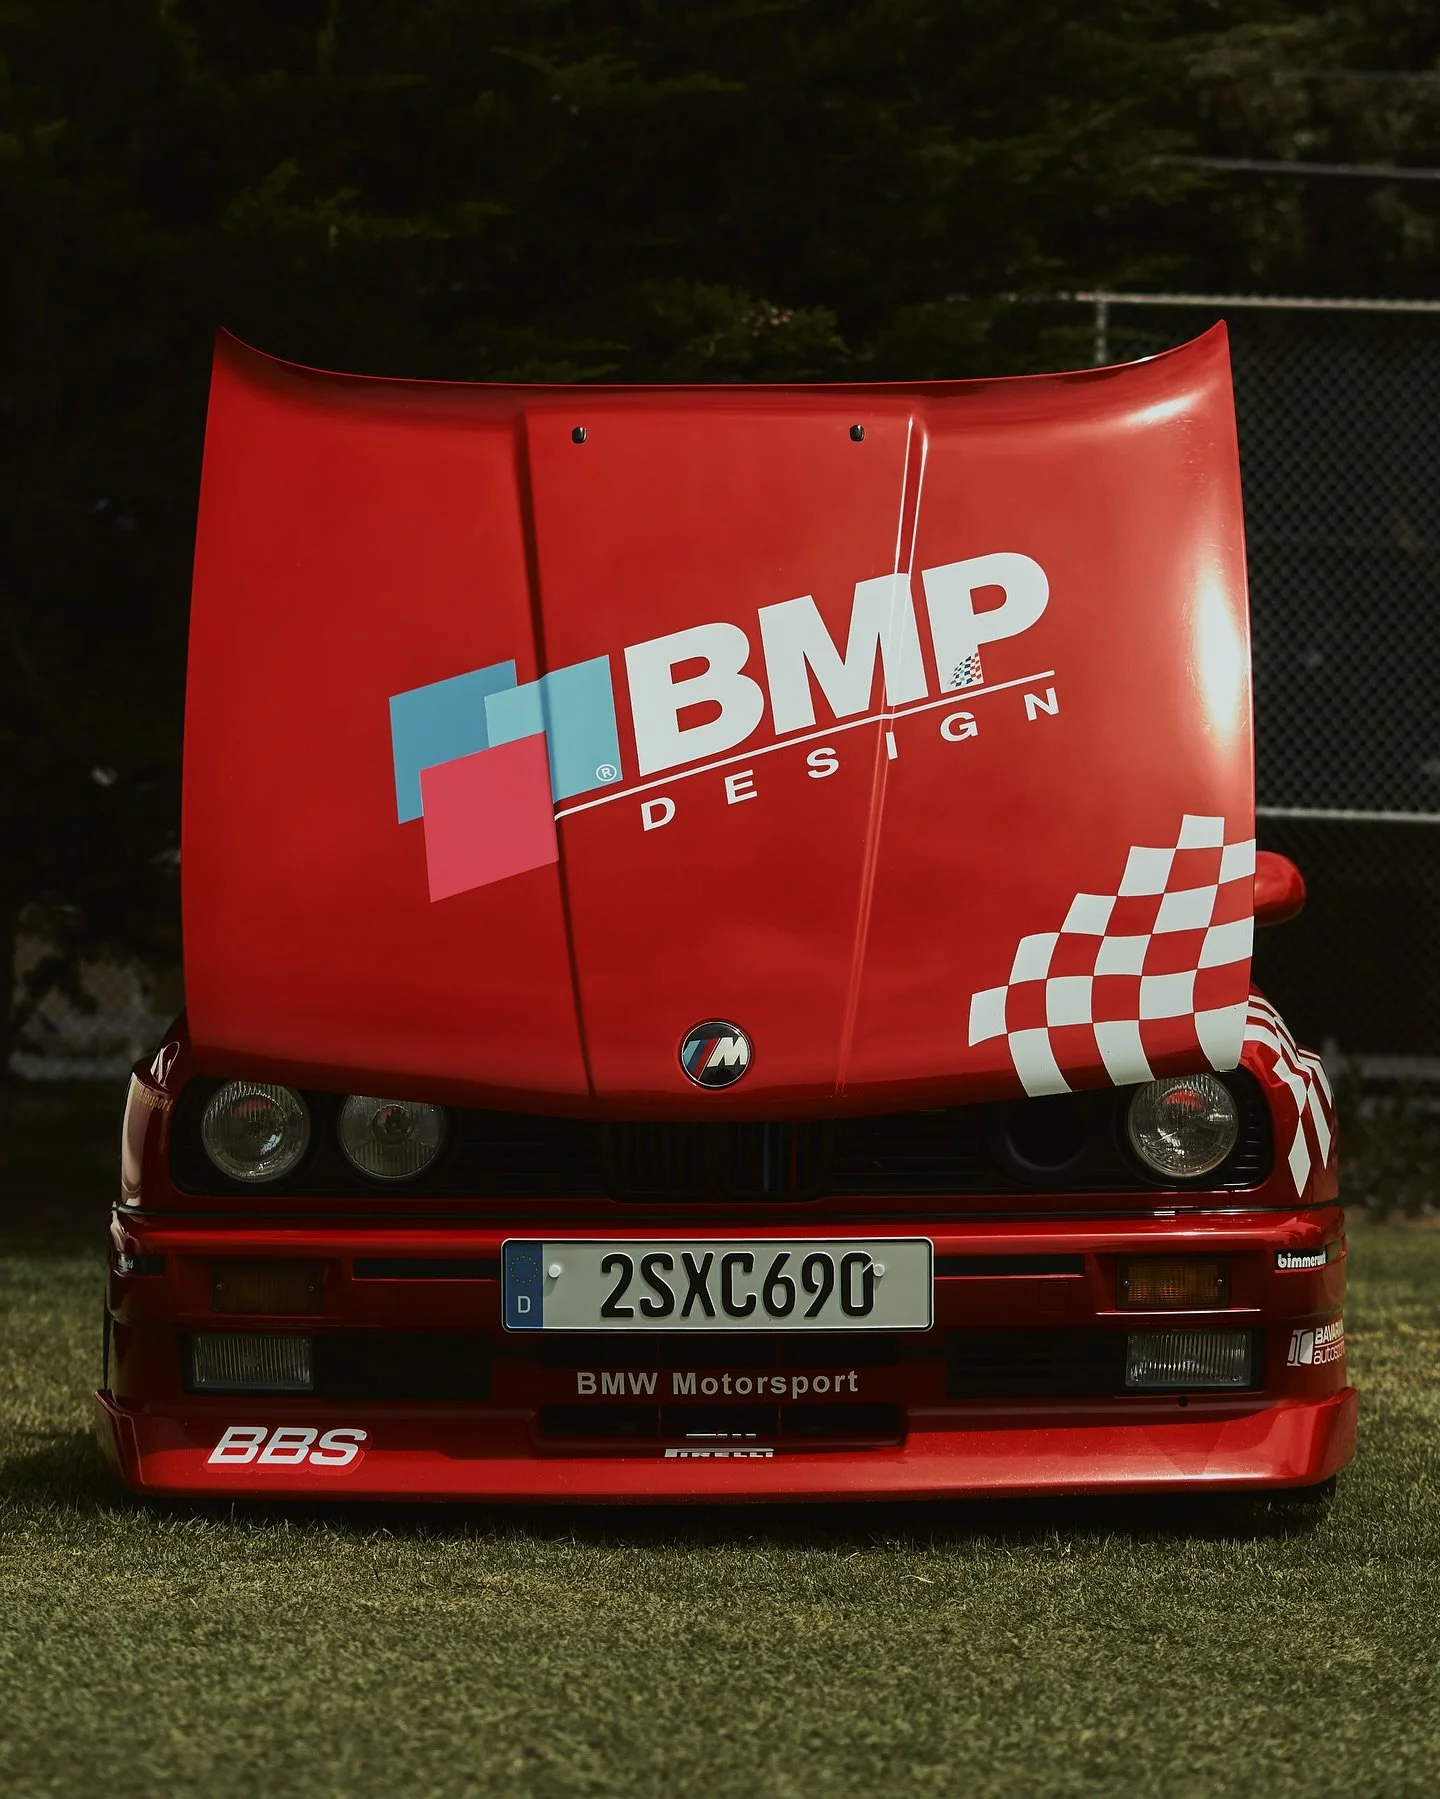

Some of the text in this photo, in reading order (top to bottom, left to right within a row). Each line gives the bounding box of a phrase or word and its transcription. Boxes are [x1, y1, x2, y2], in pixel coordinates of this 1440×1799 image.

[623, 552, 1050, 776] BMP
[641, 687, 1060, 831] DESIGN
[517, 1296, 531, 1313] D
[600, 1252, 875, 1318] 2SXC690
[577, 1370, 859, 1399] BMW Motorsport
[207, 1426, 367, 1466] BBS
